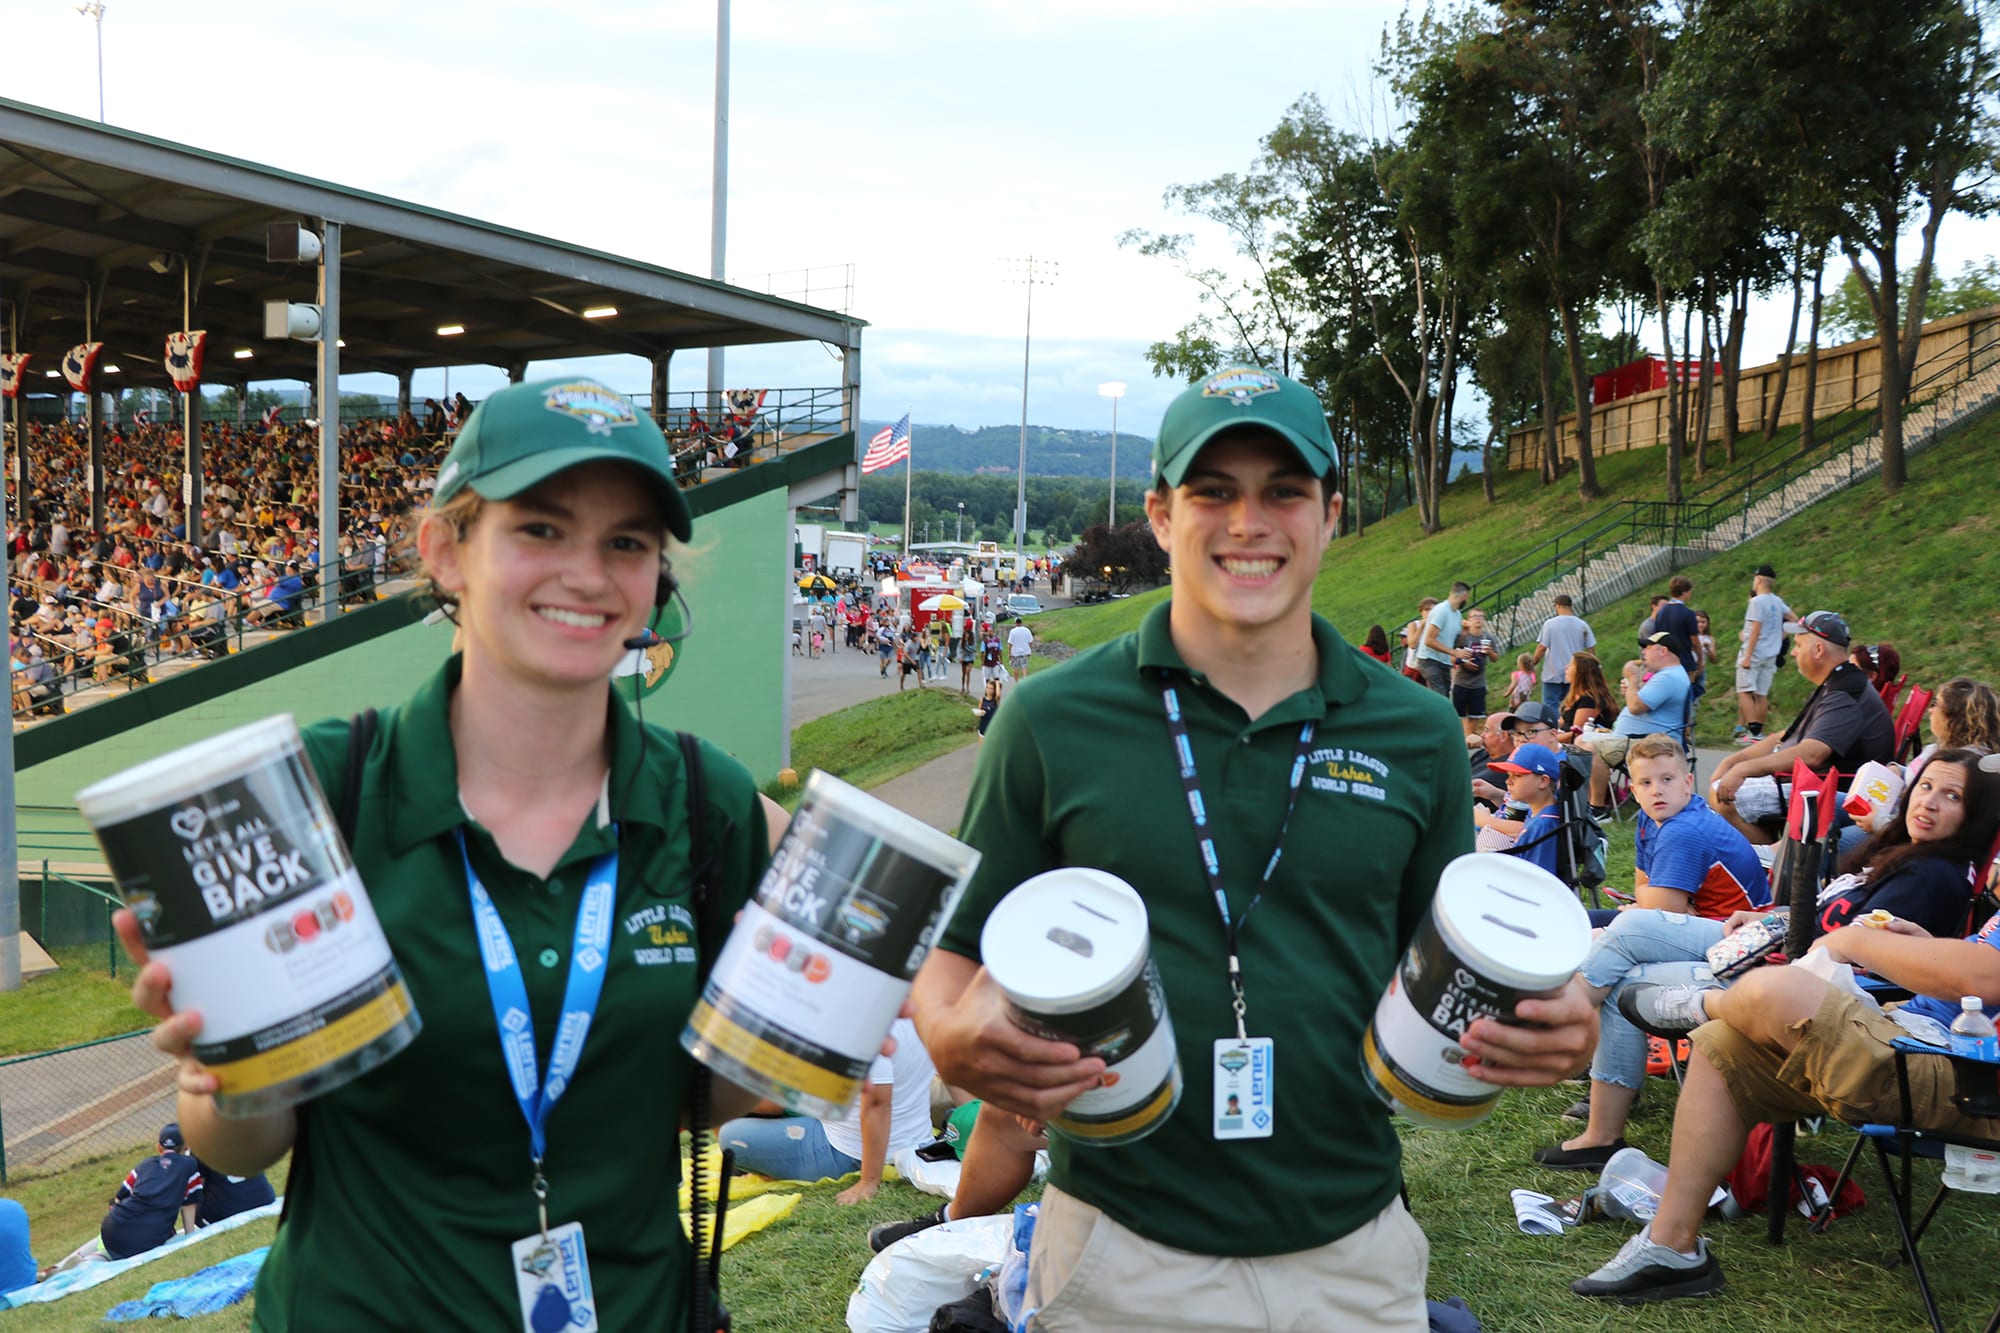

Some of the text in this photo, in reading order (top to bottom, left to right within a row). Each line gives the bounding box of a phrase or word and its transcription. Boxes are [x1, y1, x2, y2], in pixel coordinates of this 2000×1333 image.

[1308, 748, 1390, 778] LITTLE LEAGUE
[1311, 776, 1386, 801] WORLD SERIES
[236, 816, 267, 842] ALL
[192, 834, 278, 888] GIVE
[202, 849, 311, 920] BACK
[624, 904, 667, 935] LITTLE
[1821, 896, 1853, 934] C
[634, 946, 674, 966] WORLD
[1432, 1003, 1466, 1037] BA
